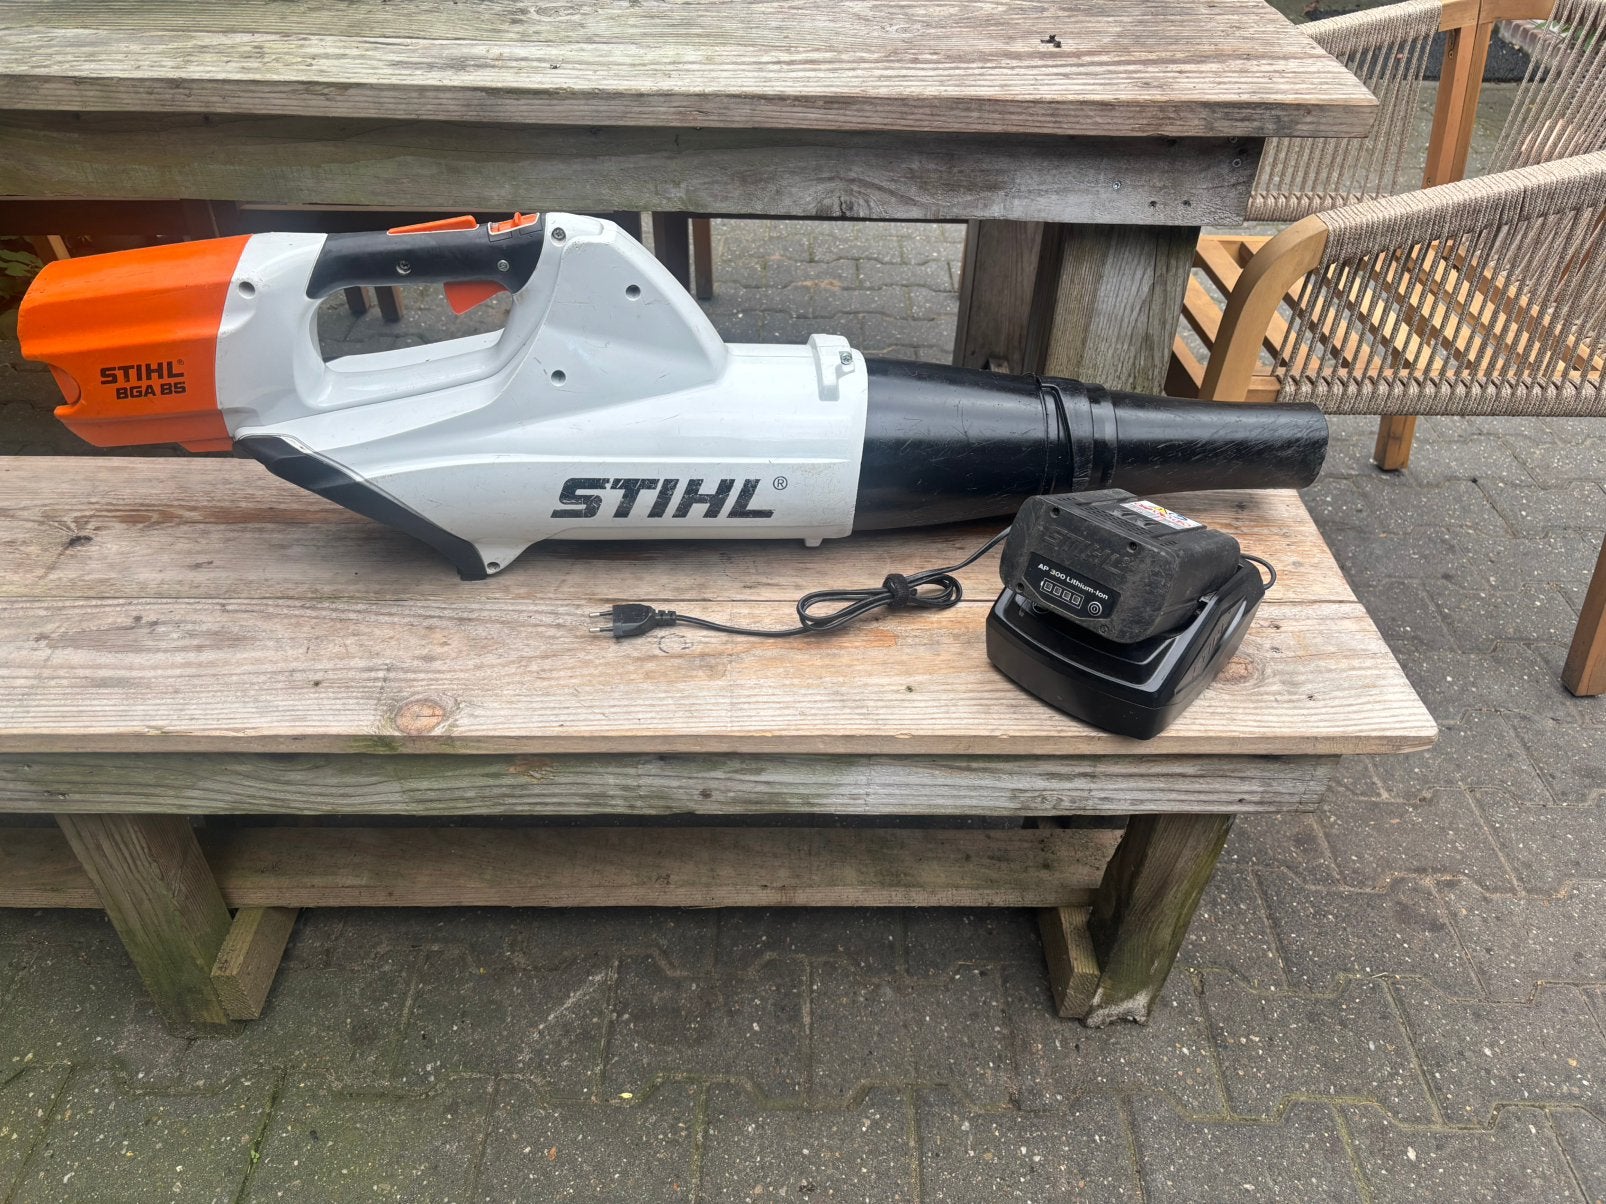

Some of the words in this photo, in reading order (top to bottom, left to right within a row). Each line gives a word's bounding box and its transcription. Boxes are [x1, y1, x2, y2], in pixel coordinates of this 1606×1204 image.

[100, 361, 184, 385] STIHL
[116, 384, 156, 400] BGA
[160, 382, 187, 396] 85
[550, 478, 775, 519] STIHL
[1038, 563, 1049, 571] AP
[1049, 568, 1066, 580] 300
[1066, 576, 1108, 600] Lithium-Ion
